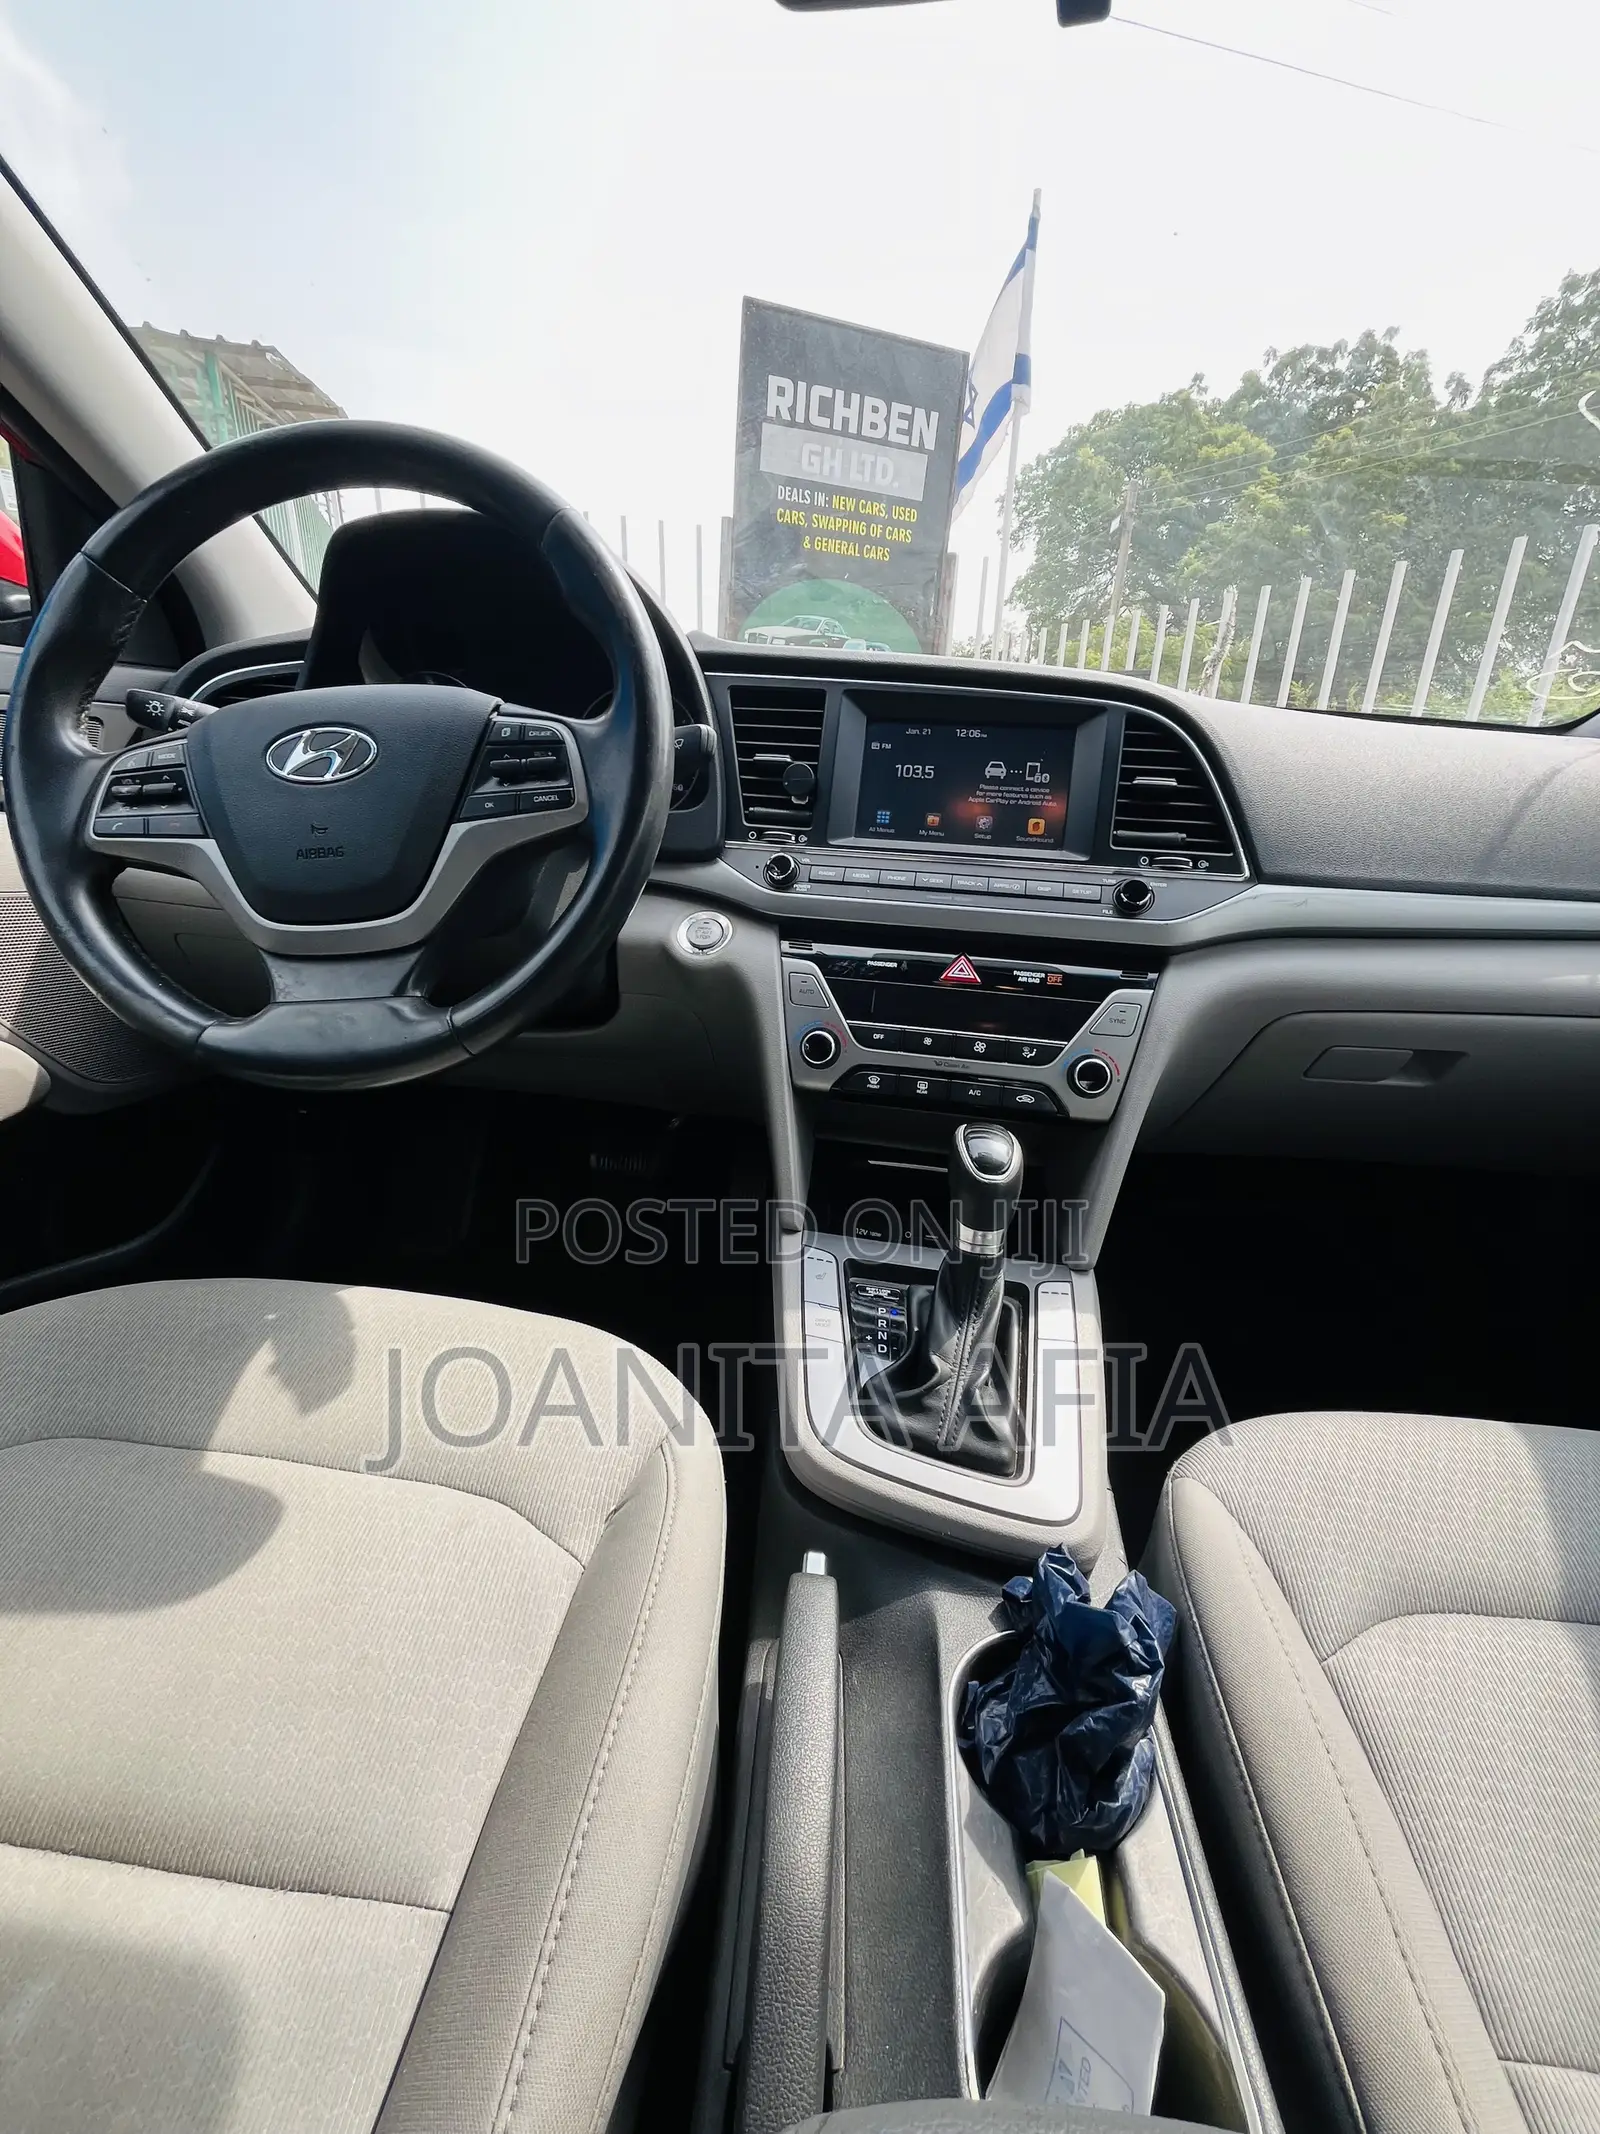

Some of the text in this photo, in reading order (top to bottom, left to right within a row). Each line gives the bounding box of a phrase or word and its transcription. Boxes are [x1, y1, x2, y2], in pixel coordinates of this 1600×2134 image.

[765, 374, 940, 451] RICHBEN
[801, 442, 899, 489] GH LTD.
[777, 485, 917, 522] DEALS IN: NEW CARS, USED
[776, 508, 912, 543] CARS, SWAPPING OF CARS
[803, 535, 890, 561] & GENERAL CARS
[955, 729, 981, 738] 12:06
[895, 764, 934, 779] 103.5
[296, 846, 345, 860] AIRBAG
[866, 960, 898, 968] PASSENGER
[1013, 970, 1045, 978] PASSENGER
[1047, 975, 1062, 983] OFF
[1109, 1017, 1126, 1025] SYNC
[855, 1227, 869, 1236] 12V
[878, 1307, 887, 1315] P
[878, 1319, 887, 1328] R
[877, 1331, 887, 1340] N
[877, 1344, 887, 1353] D
